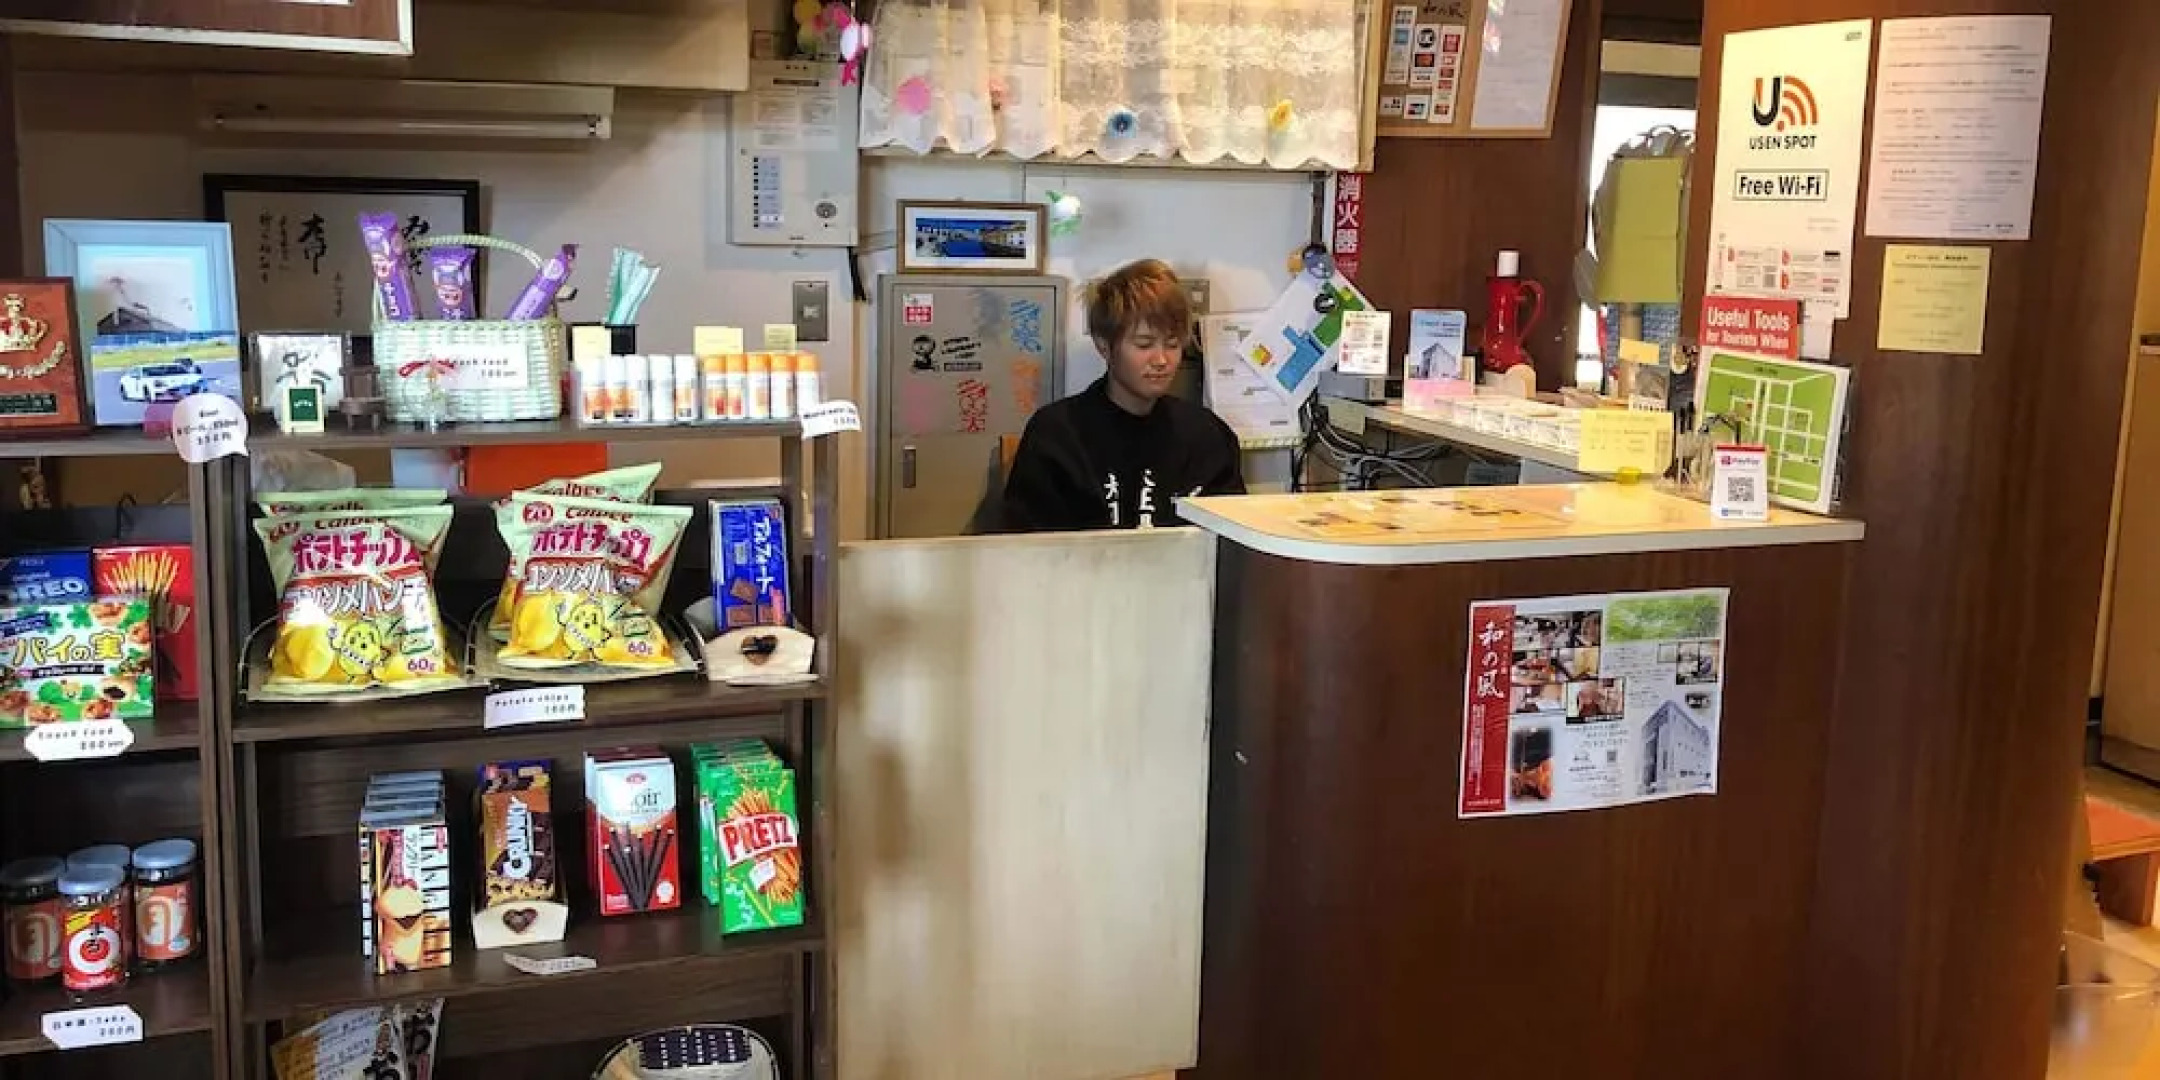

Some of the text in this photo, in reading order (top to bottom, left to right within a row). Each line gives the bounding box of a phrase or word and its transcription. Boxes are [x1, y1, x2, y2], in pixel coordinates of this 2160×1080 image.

[1750, 135, 1817, 149] USEN SPOT
[1739, 176, 1821, 195] Free Wi-Fi
[1335, 174, 1361, 254] 消火器
[1707, 306, 1790, 332] Useful Tools
[1706, 328, 1789, 349] for Tourists When
[13, 629, 124, 666] パイの実
[1477, 620, 1505, 698] 和の風
[407, 659, 435, 672] 60g
[723, 815, 793, 862] PRETZ
